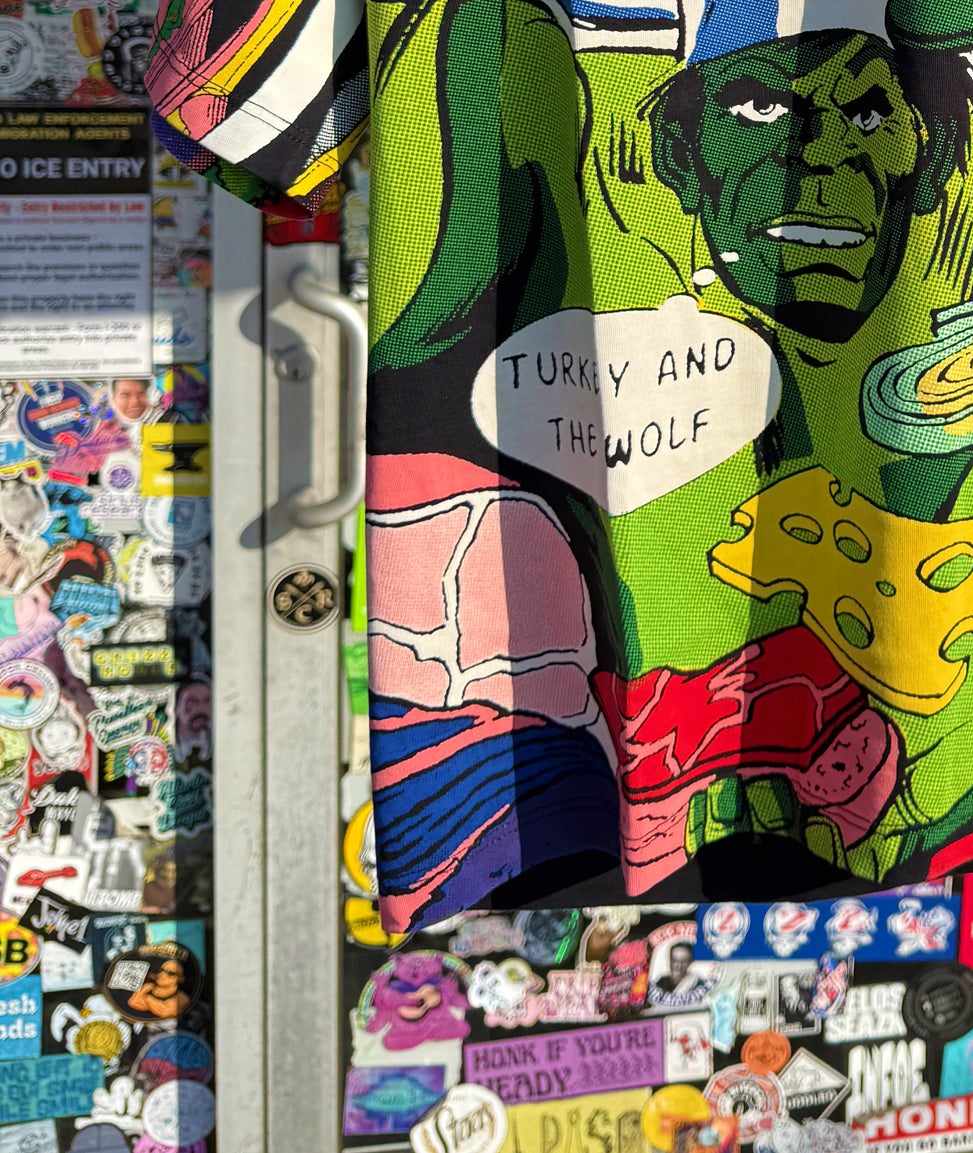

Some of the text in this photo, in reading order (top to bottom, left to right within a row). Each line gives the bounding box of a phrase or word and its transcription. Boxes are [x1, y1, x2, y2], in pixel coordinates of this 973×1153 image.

[23, 157, 62, 178] ICE
[67, 157, 146, 179] ENTRY
[502, 337, 735, 397] TURKEY AND
[548, 408, 710, 469] THE WOLF
[0, 939, 29, 964] B
[473, 1042, 537, 1073] HONK
[546, 1037, 568, 1063] IF
